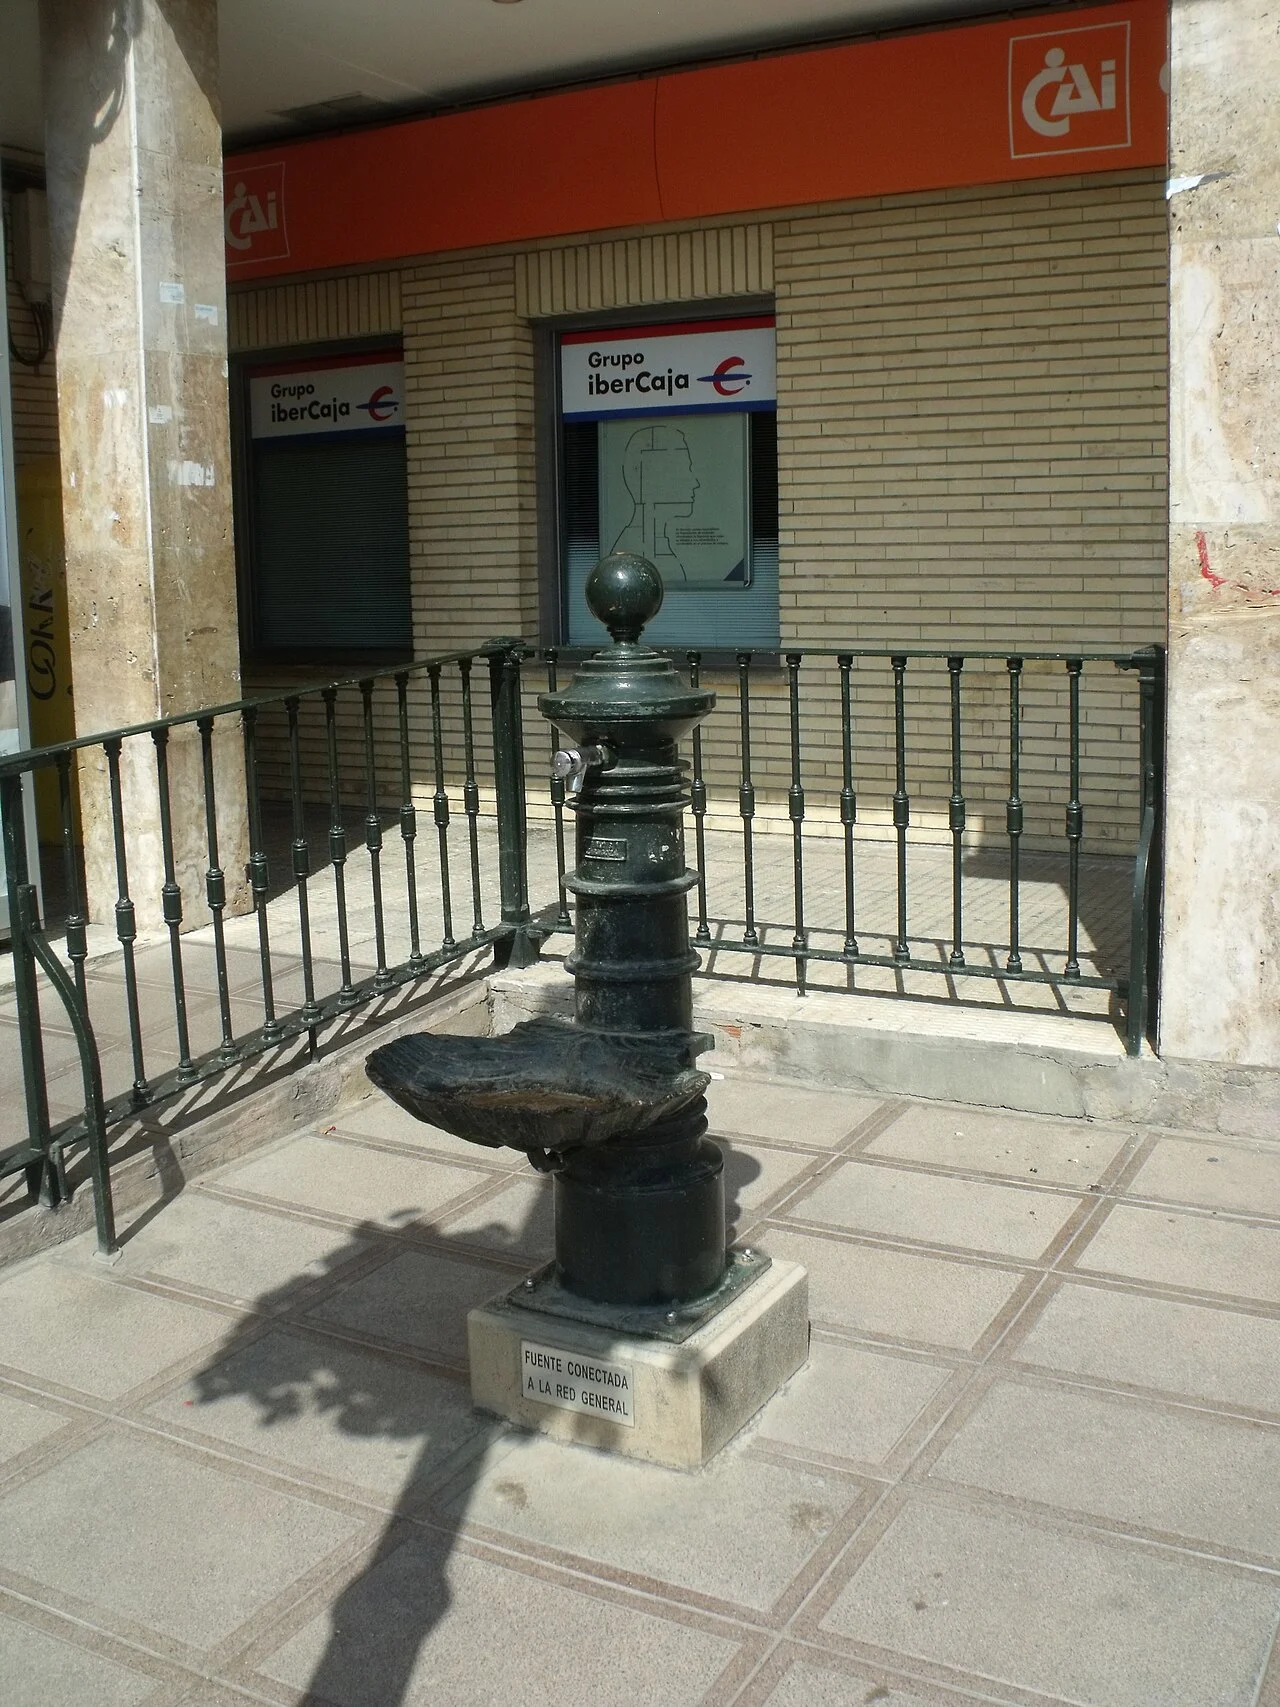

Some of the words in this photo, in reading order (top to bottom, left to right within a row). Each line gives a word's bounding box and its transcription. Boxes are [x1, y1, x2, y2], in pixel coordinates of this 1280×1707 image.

[588, 351, 645, 370] Grupo
[270, 383, 315, 400] Grupo
[588, 368, 690, 396] iberCaja
[270, 397, 350, 423] iberCaja
[525, 1350, 562, 1373] FUENTE
[567, 1361, 629, 1390] CONECTADA
[527, 1376, 535, 1390] A
[539, 1379, 552, 1396] LA
[556, 1384, 576, 1401] RED
[581, 1390, 629, 1416] GENERAL
